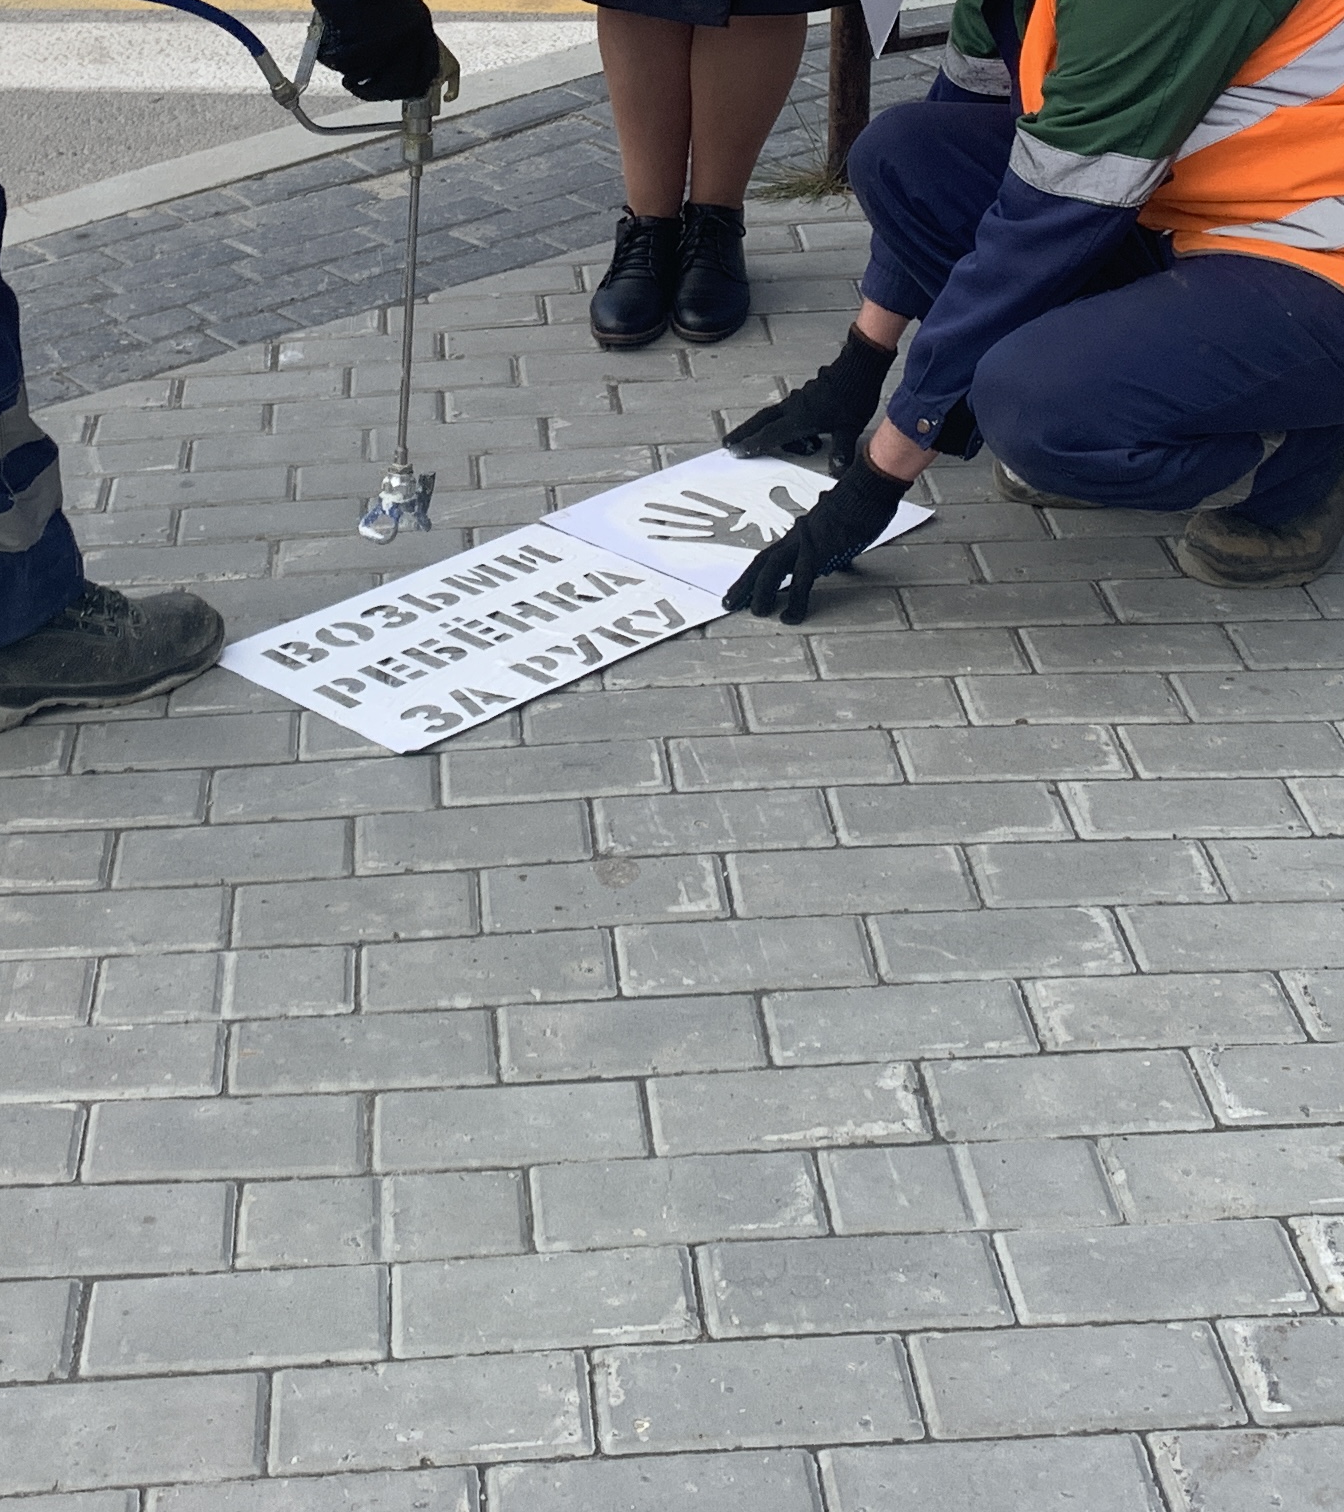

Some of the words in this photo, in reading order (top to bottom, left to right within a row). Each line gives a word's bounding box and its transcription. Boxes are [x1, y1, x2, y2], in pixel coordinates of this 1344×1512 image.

[260, 544, 564, 671] ВОЗЬМИ
[312, 569, 646, 709] РЕБЁНКА
[399, 686, 518, 734] ЗА
[507, 597, 687, 686] РУКУ
